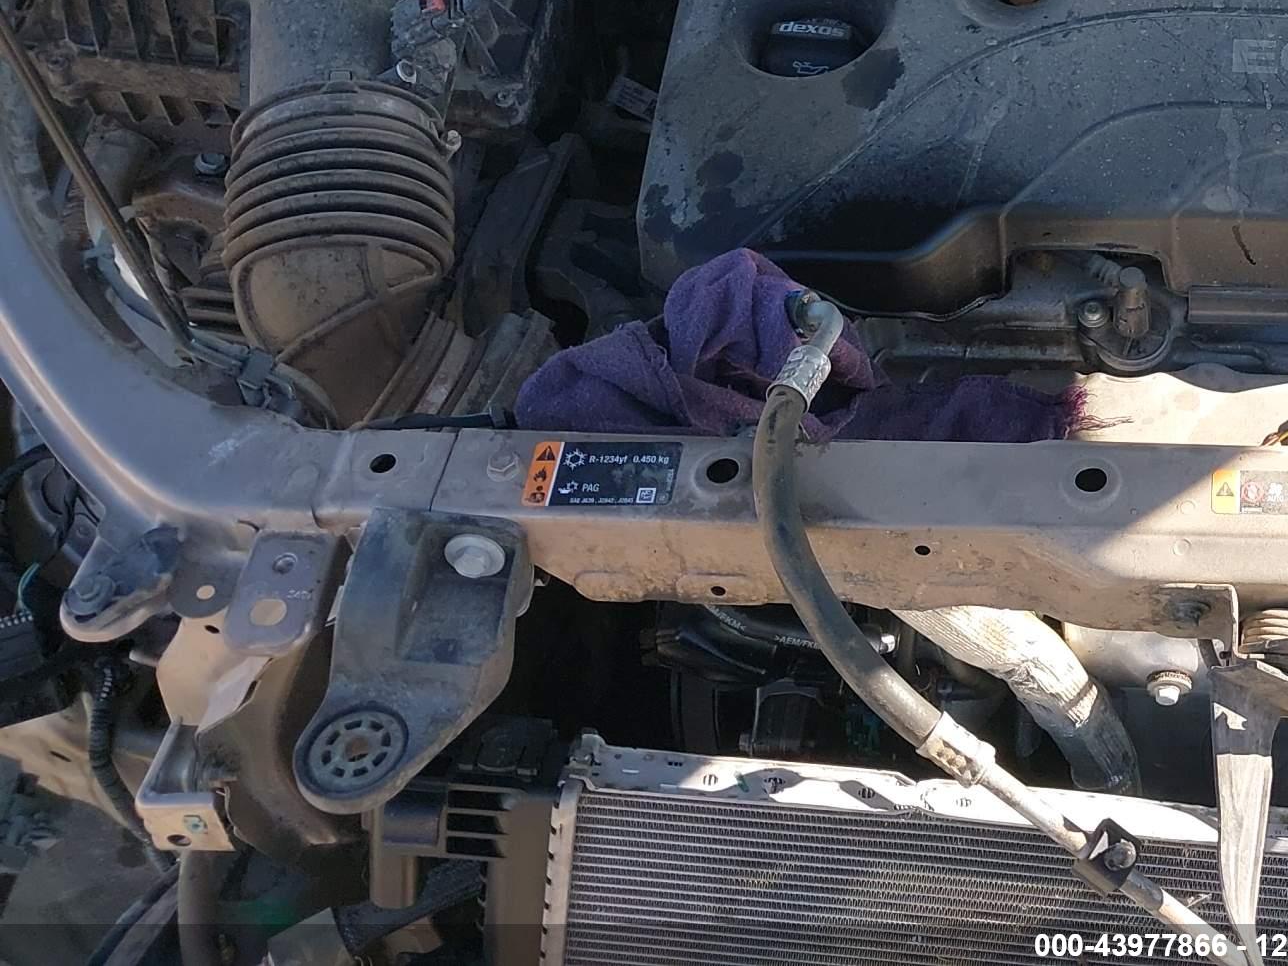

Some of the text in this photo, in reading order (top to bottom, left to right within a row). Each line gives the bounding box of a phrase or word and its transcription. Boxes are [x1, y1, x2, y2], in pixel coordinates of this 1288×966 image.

[779, 21, 846, 37] dexos
[589, 455, 670, 465] R-1234yf 0.450 kg
[582, 483, 600, 492] PAG
